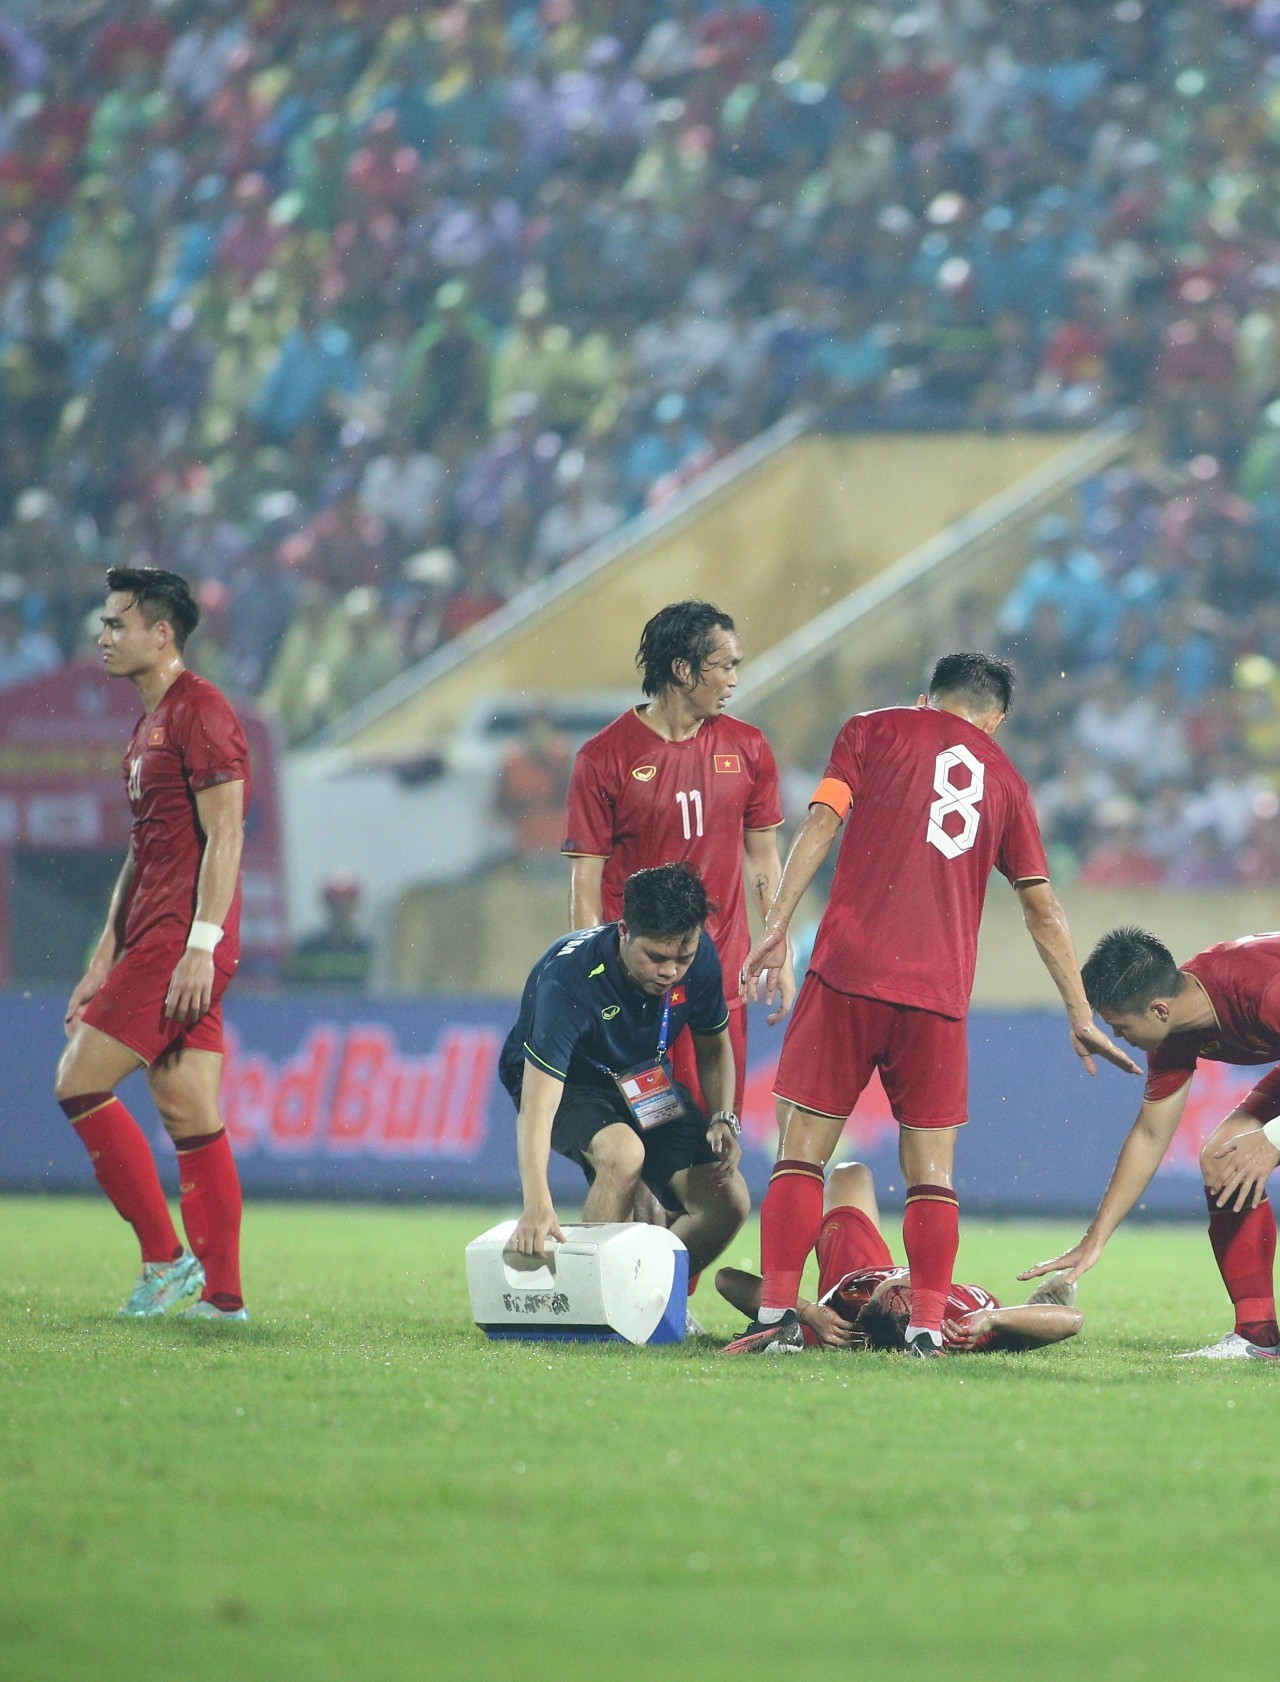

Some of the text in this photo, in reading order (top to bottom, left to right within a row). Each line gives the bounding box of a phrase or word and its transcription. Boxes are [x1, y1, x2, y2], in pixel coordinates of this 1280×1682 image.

[675, 789, 704, 840] 11
[926, 744, 985, 860] 8
[223, 1032, 494, 1145] ed Bull
